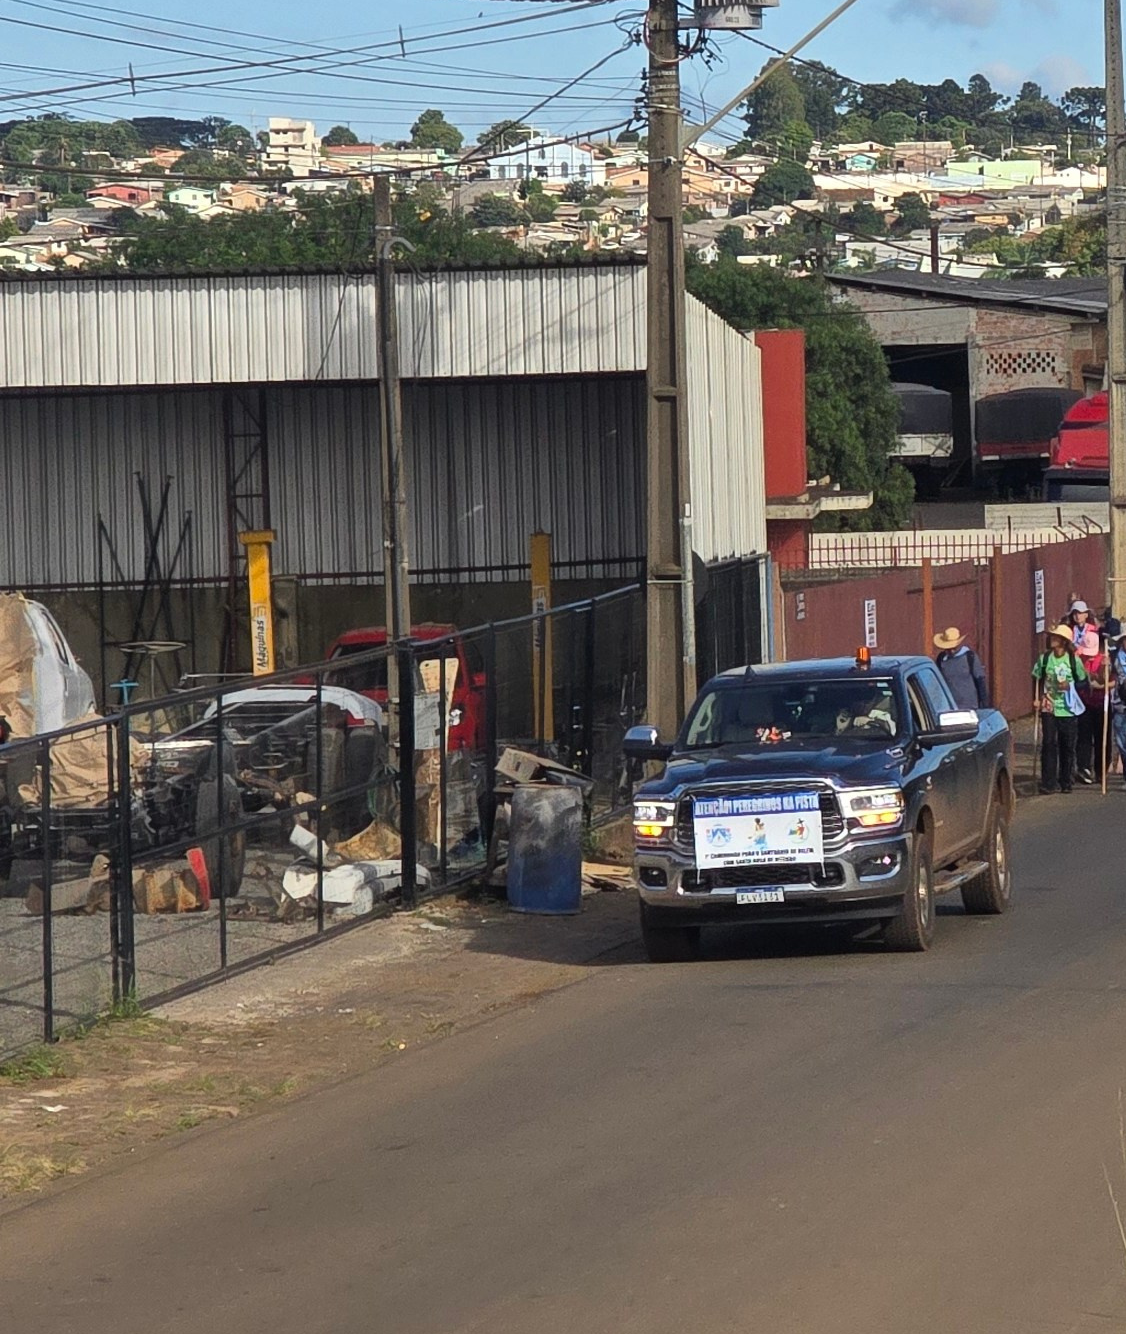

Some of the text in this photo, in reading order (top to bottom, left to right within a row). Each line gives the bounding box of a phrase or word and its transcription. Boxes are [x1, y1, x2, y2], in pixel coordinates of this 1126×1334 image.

[256, 620, 267, 668] Máquinas
[733, 796, 782, 814] PEREGRINOS
[795, 794, 819, 810] PISTA
